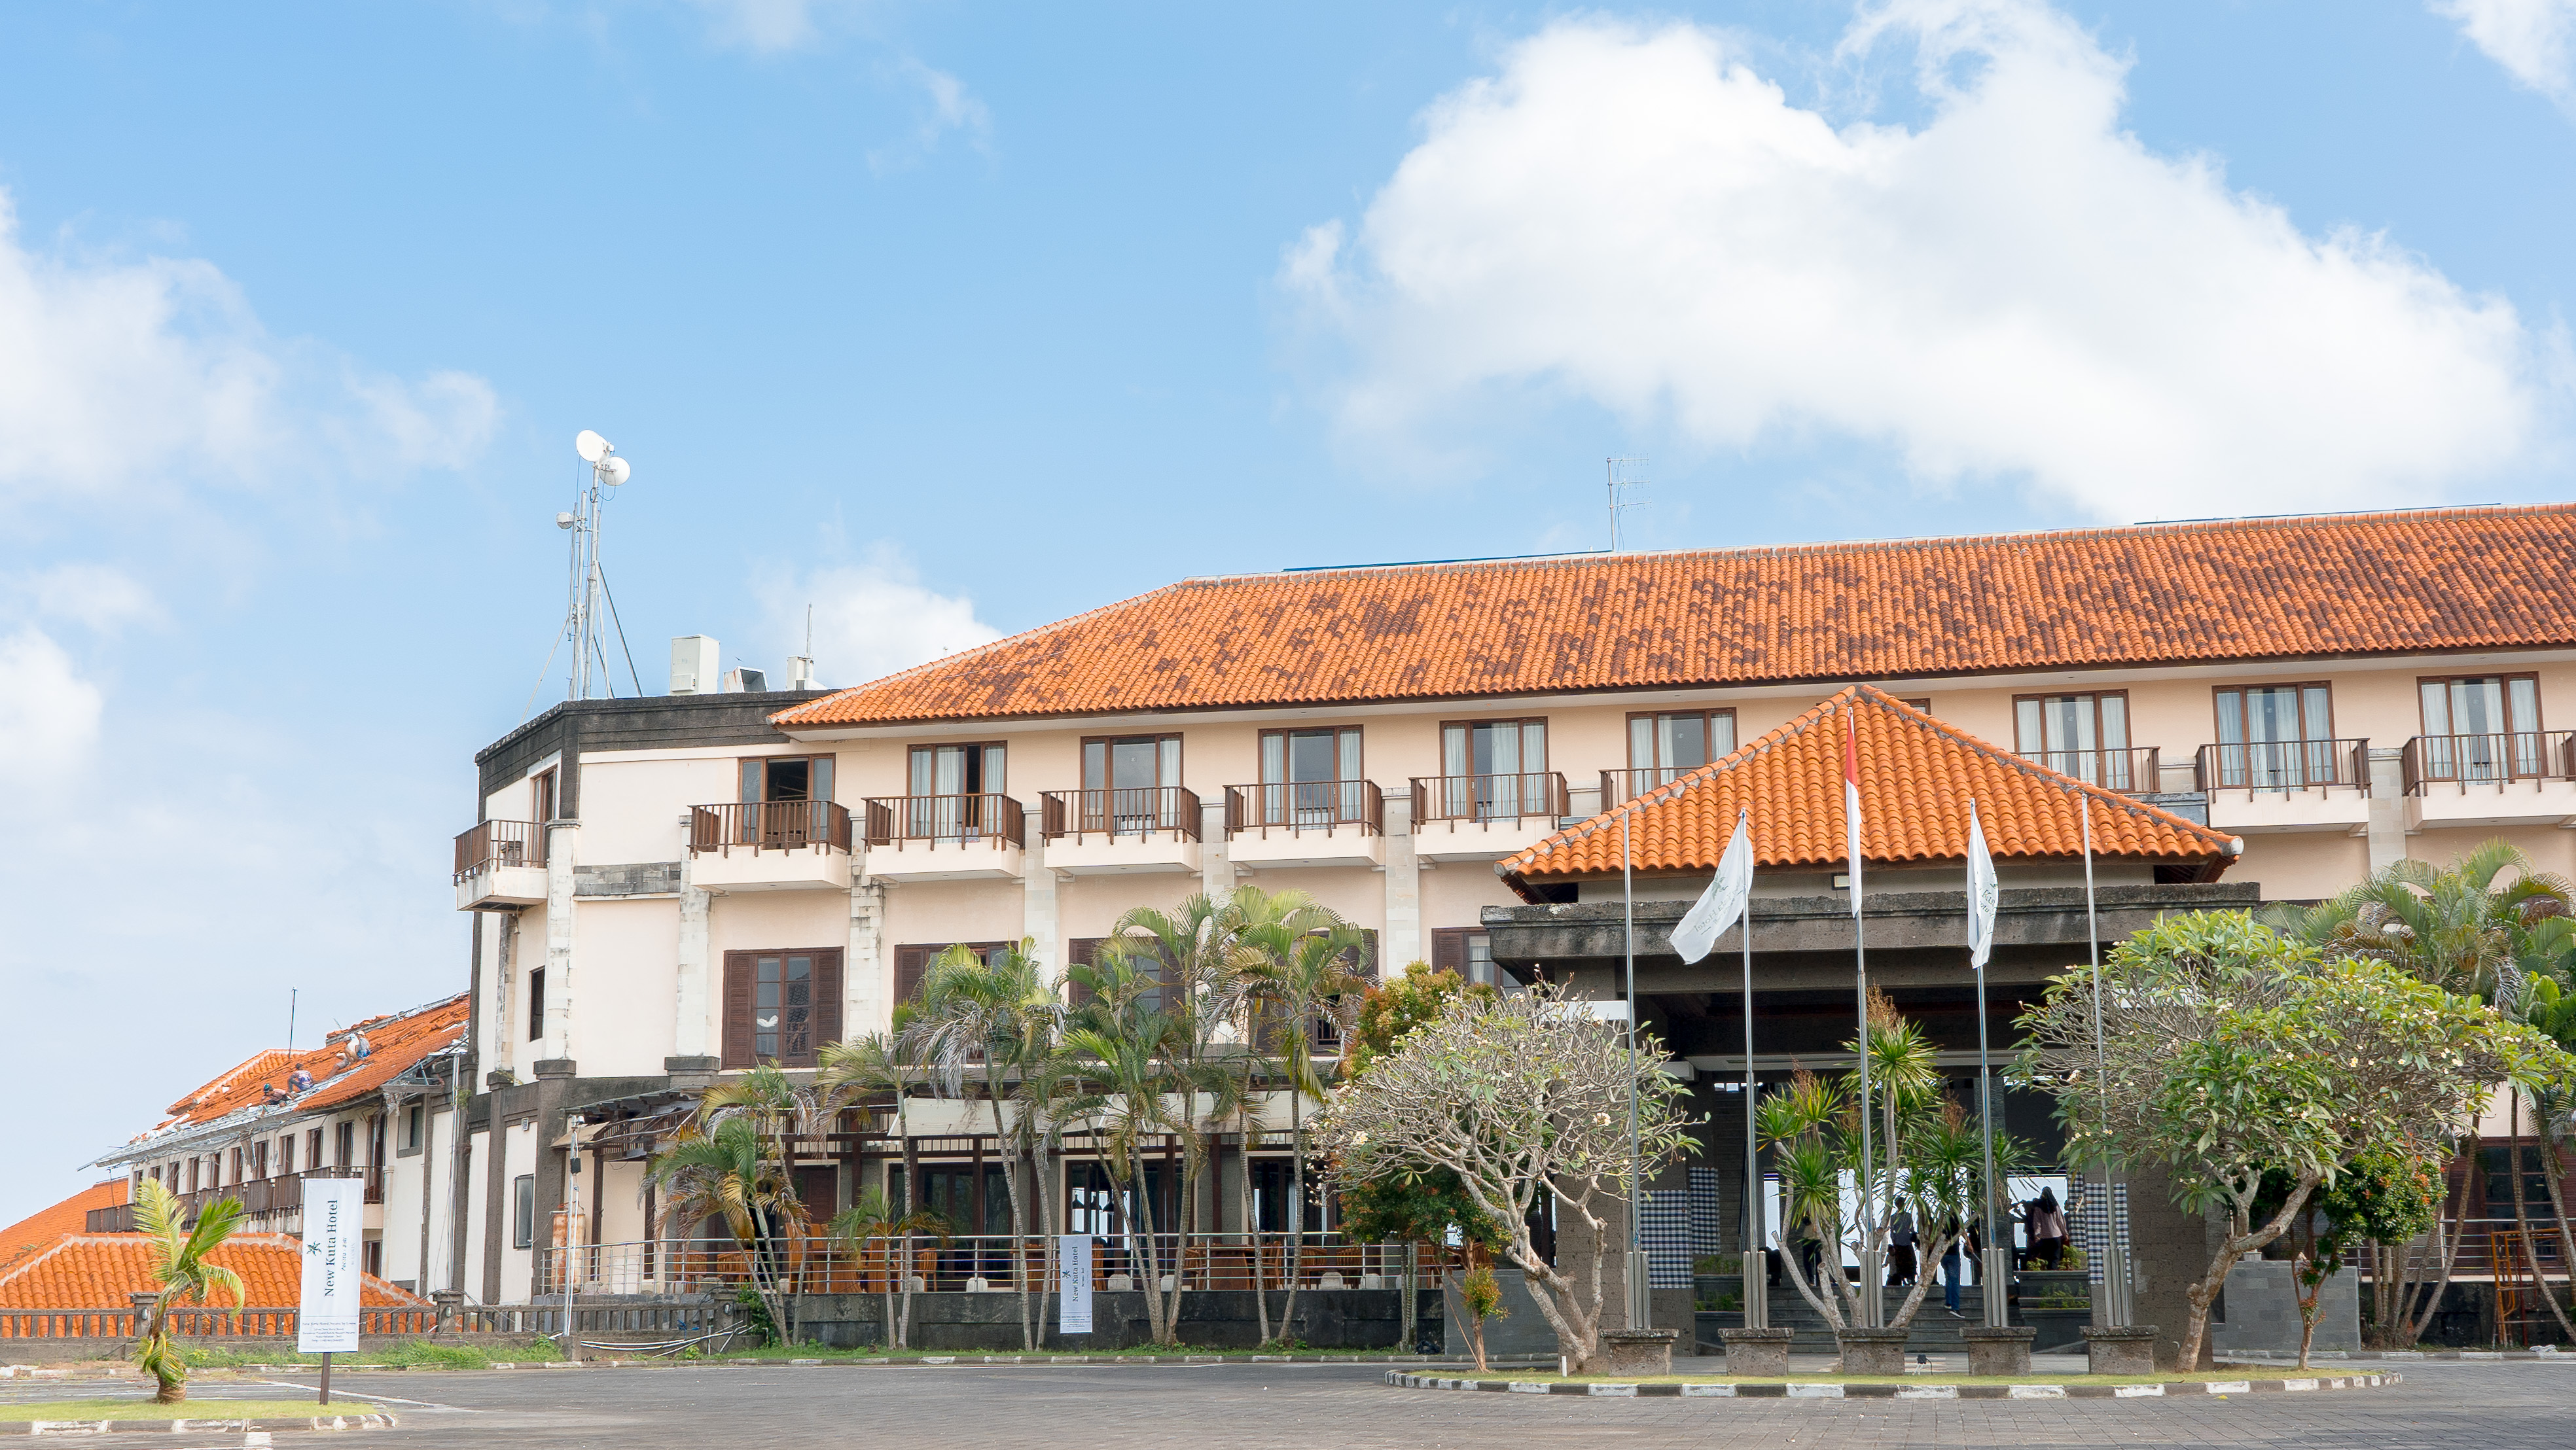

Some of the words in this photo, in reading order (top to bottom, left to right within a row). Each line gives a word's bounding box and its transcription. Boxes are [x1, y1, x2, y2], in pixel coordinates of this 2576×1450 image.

[327, 1199, 338, 1233] Hotel
[325, 1237, 336, 1265] Kuta
[324, 1269, 334, 1297] New
